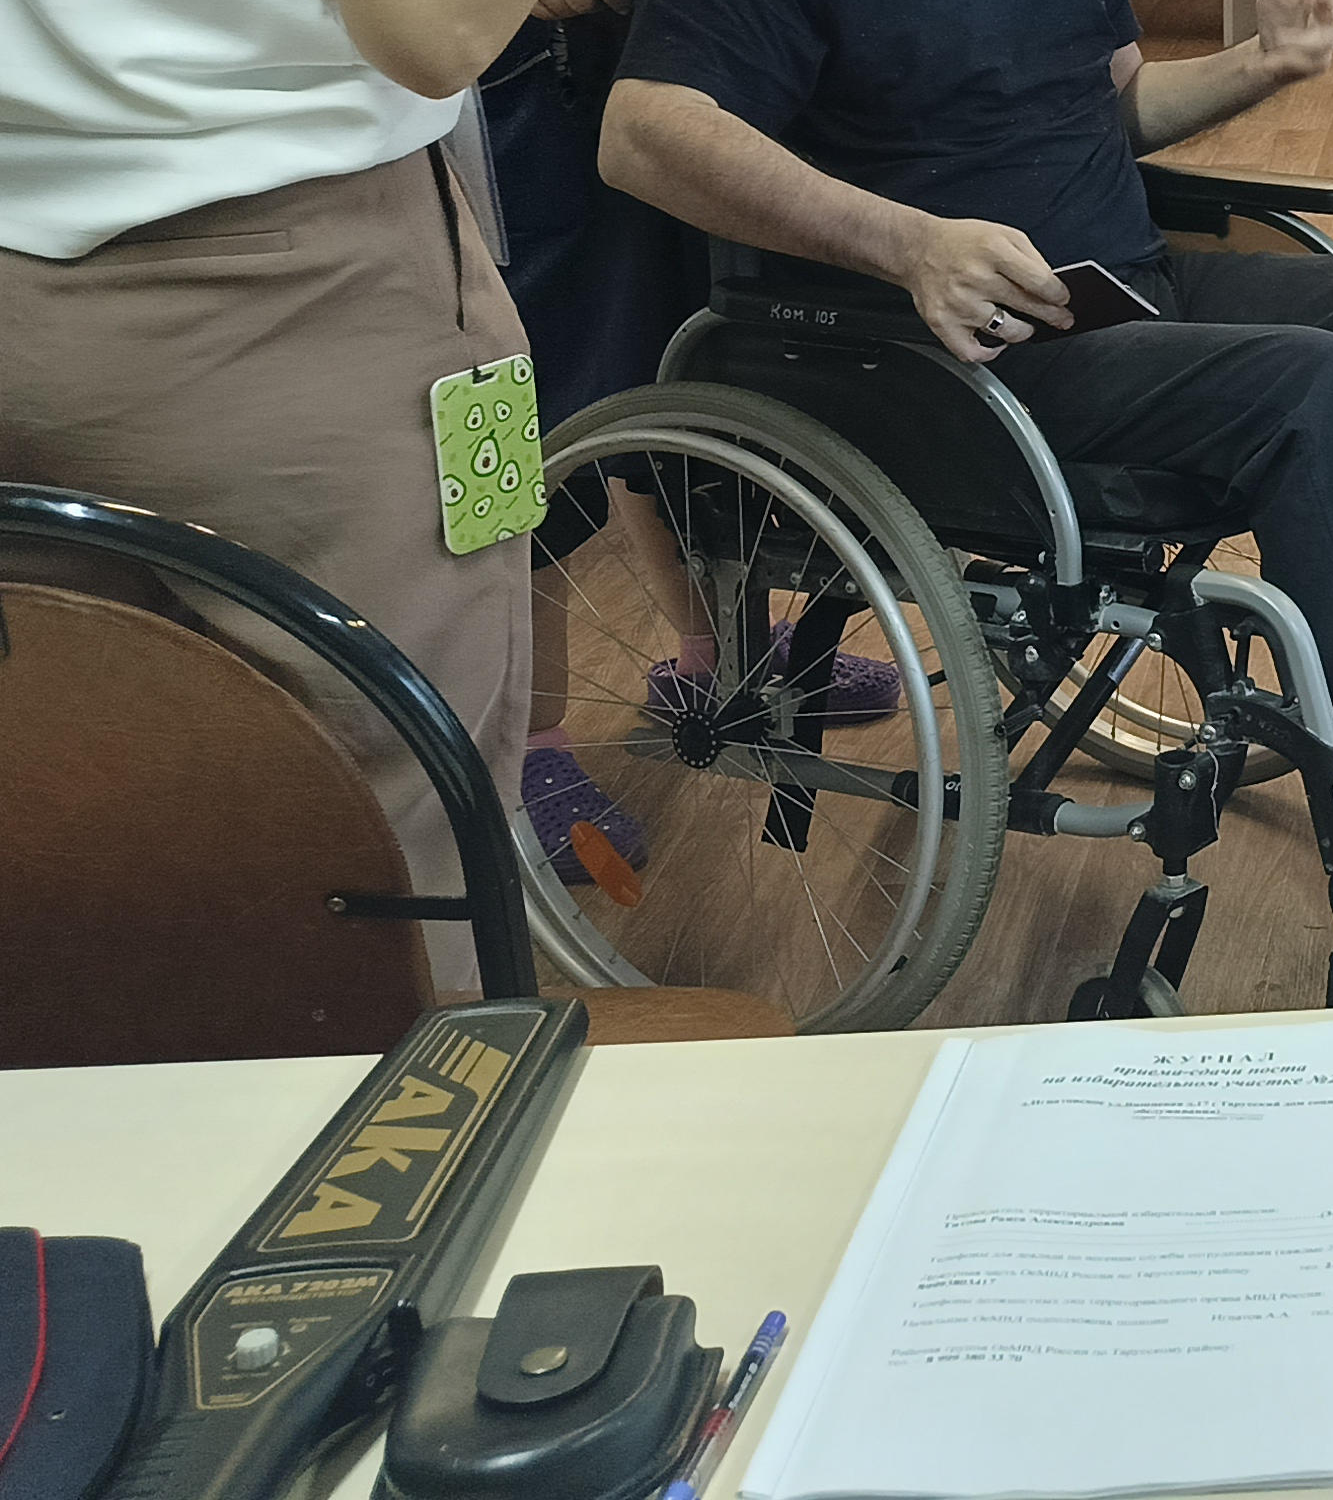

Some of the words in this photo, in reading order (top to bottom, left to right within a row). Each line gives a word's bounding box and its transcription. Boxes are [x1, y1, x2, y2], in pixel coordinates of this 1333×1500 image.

[815, 310, 838, 325] 105
[1247, 1064, 1307, 1075] поста
[1042, 1076, 1066, 1084] на
[1071, 1075, 1219, 1088] избирательном
[1221, 1077, 1303, 1089] участке
